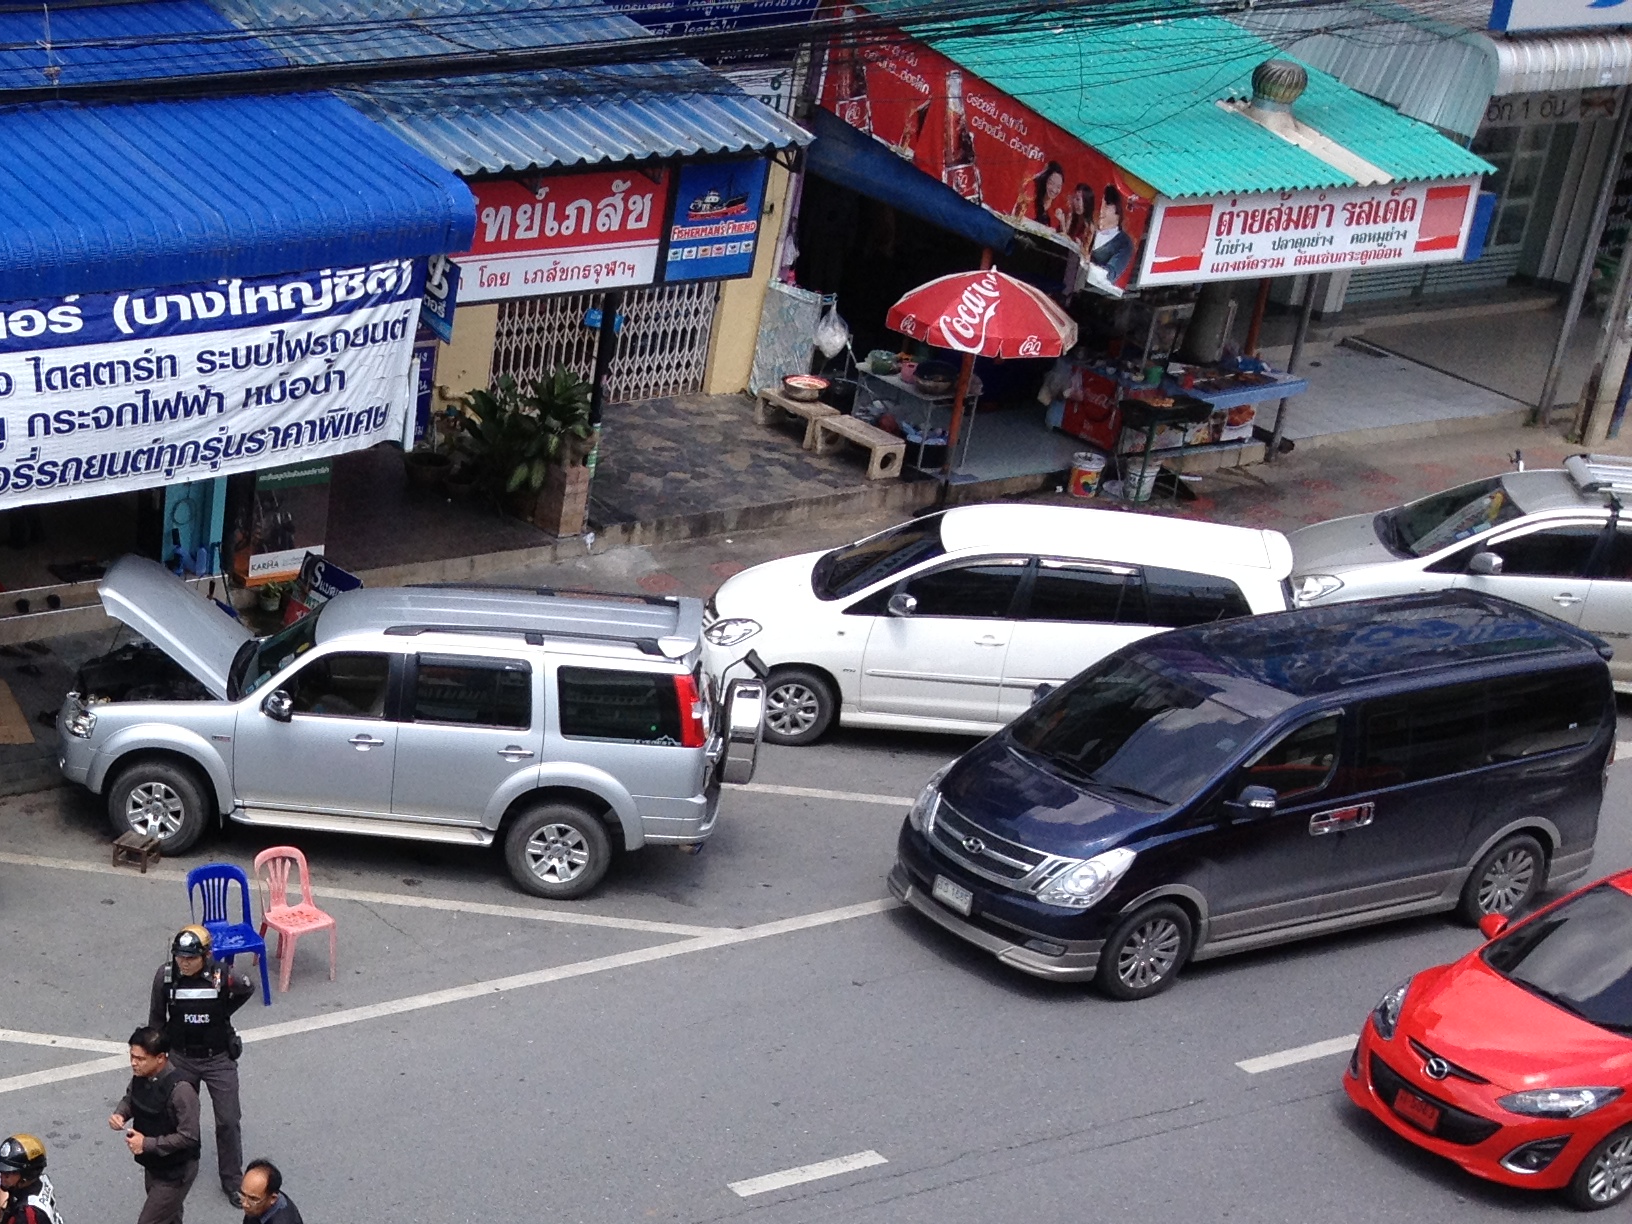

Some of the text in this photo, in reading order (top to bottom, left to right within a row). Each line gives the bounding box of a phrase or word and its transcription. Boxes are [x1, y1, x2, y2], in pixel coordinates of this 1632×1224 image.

[475, 179, 654, 243] ทย์เภสัช
[1215, 185, 1419, 237] ต่ายส้มตำ รสเด็ด
[1214, 237, 1253, 256] ไก่ย่าง
[478, 264, 510, 288] โดย
[523, 260, 636, 285] เภสัชกรจุฬาฯ
[25, 347, 178, 393] ไดสตาร์ท
[196, 308, 412, 376] ระบบไฟรถยนต์
[27, 384, 225, 438] กระจกไฟฟ้า
[241, 357, 347, 409] หม้อน้ำ
[184, 1014, 210, 1024] POLICE
